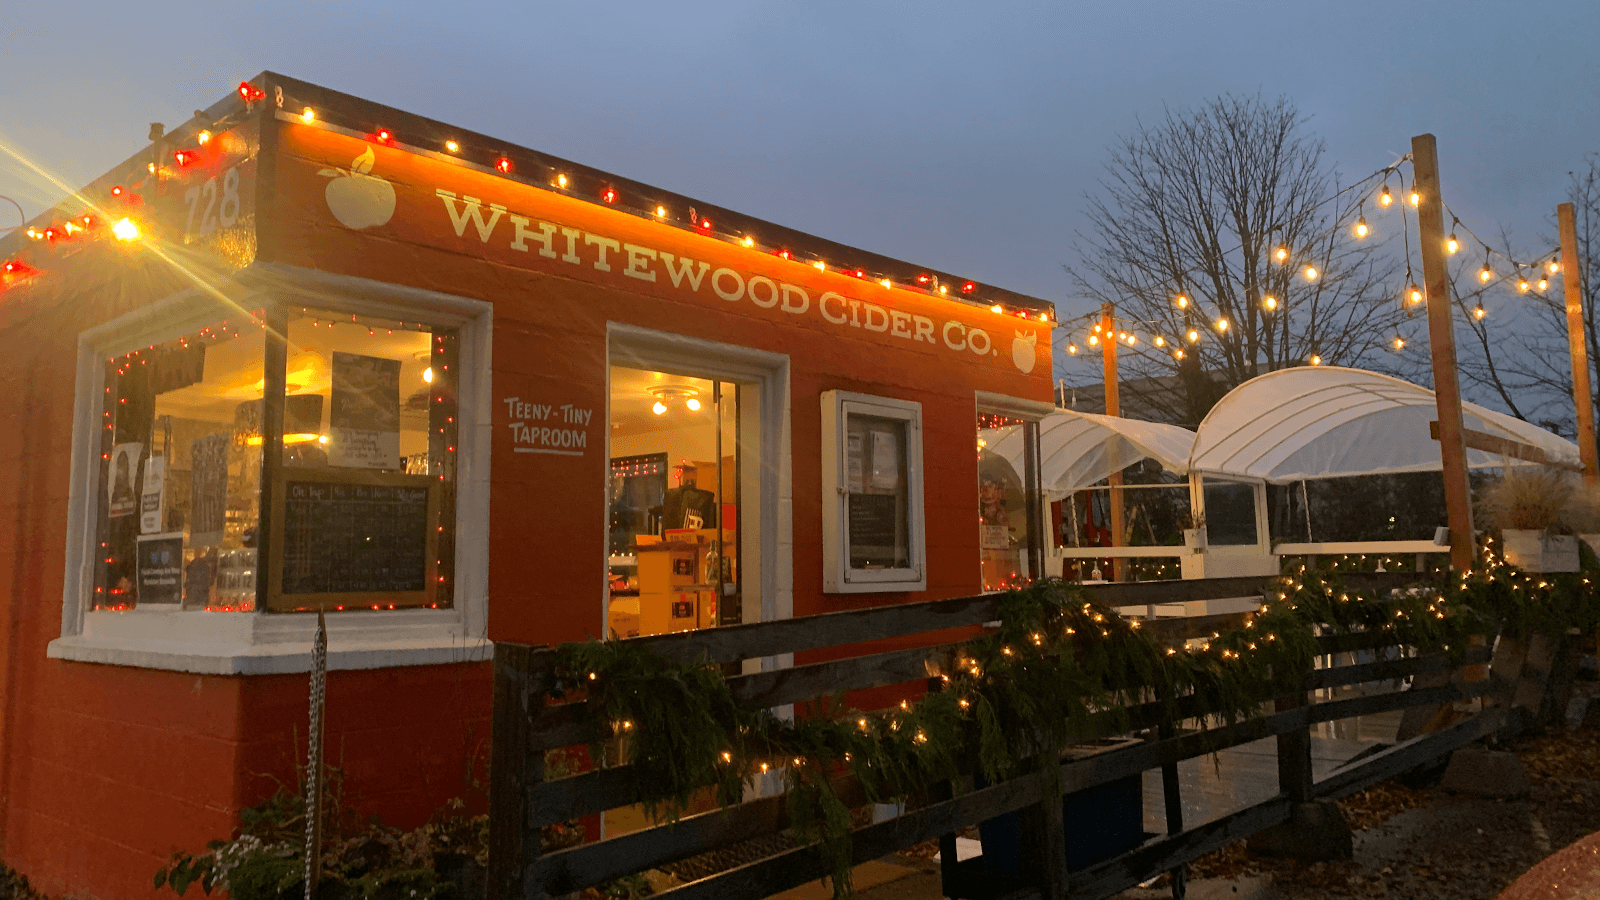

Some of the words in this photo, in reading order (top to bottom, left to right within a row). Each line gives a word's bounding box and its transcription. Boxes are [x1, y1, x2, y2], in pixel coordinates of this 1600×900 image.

[184, 167, 240, 244] 728
[436, 188, 809, 314] WHITEWOOD
[819, 291, 936, 344] CIDER
[942, 320, 998, 357] CO.
[508, 421, 587, 448] TAPROOM
